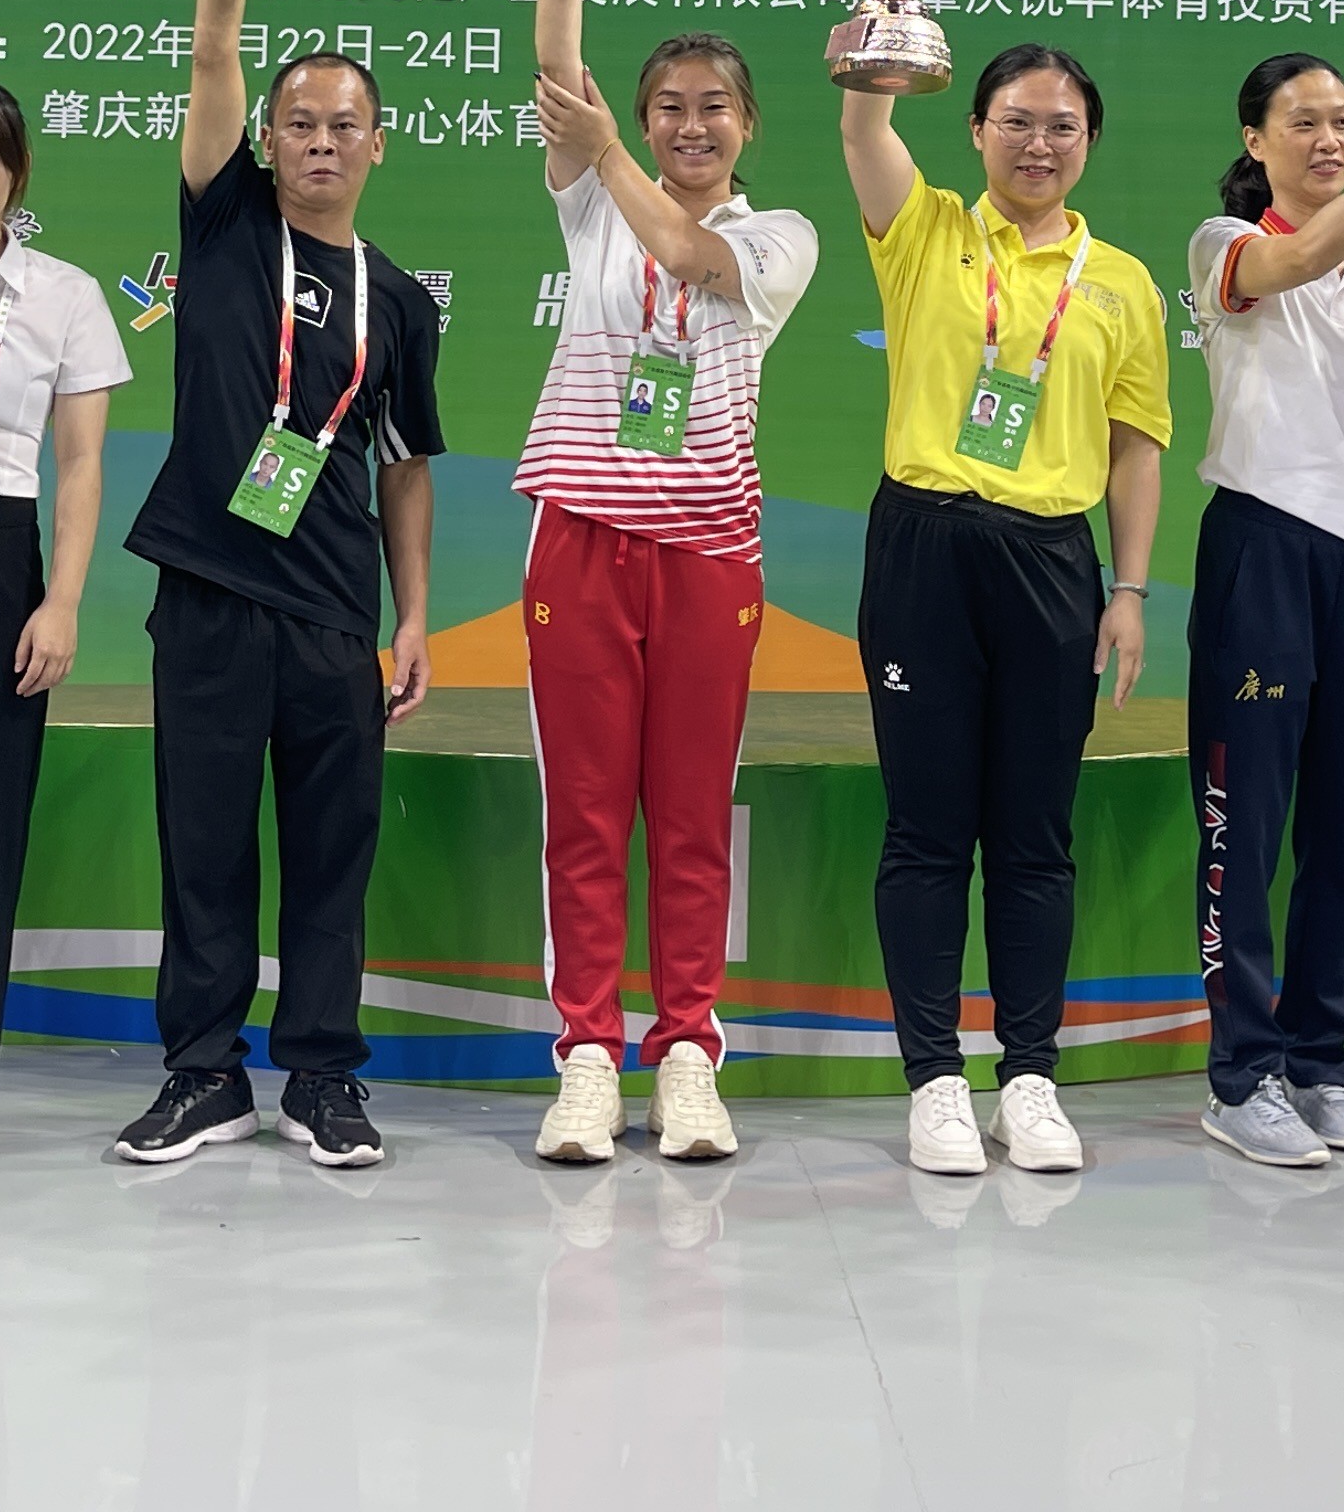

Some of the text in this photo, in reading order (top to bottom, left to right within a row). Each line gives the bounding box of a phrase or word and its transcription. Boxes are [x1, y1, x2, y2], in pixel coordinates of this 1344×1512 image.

[663, 387, 682, 412] S
[1005, 403, 1026, 427] S
[284, 467, 308, 492] S
